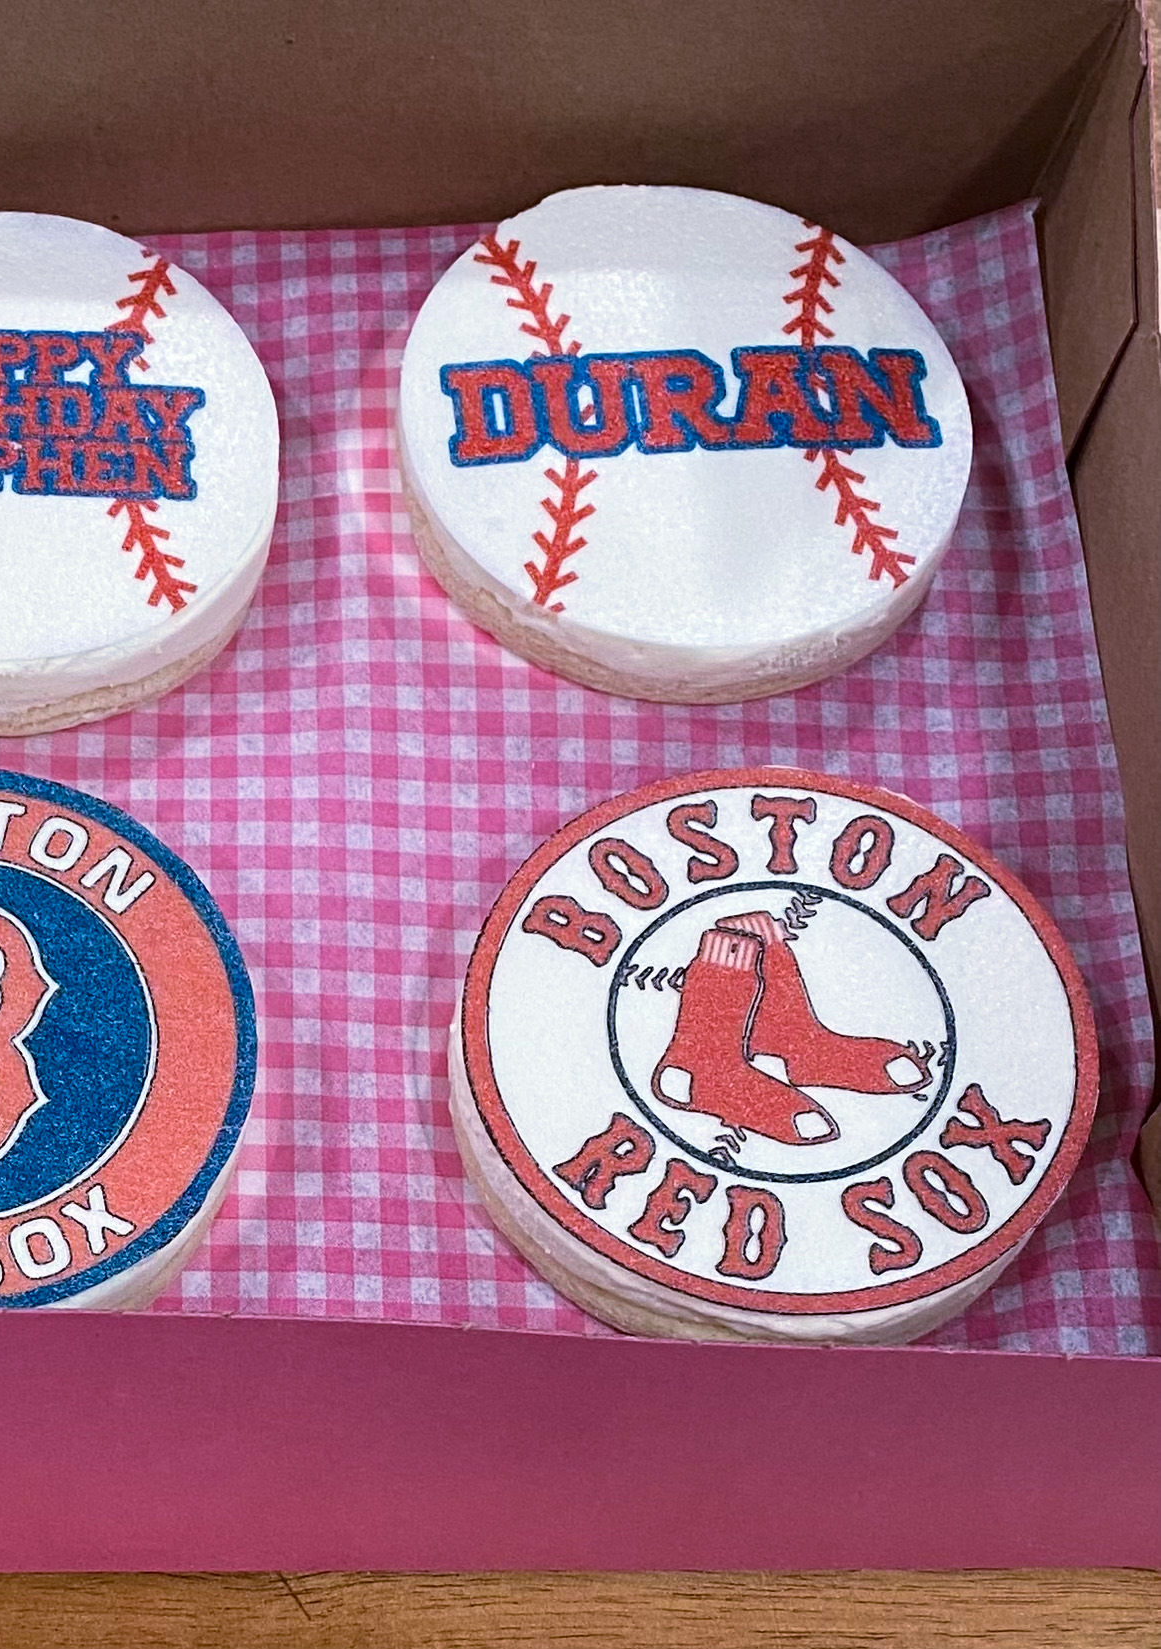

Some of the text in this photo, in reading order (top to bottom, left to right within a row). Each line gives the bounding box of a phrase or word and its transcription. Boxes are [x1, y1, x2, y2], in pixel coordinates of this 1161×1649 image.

[439, 345, 943, 467] DURAN
[523, 794, 992, 967] BOSTON
[552, 1082, 1051, 1280] RED SOX
